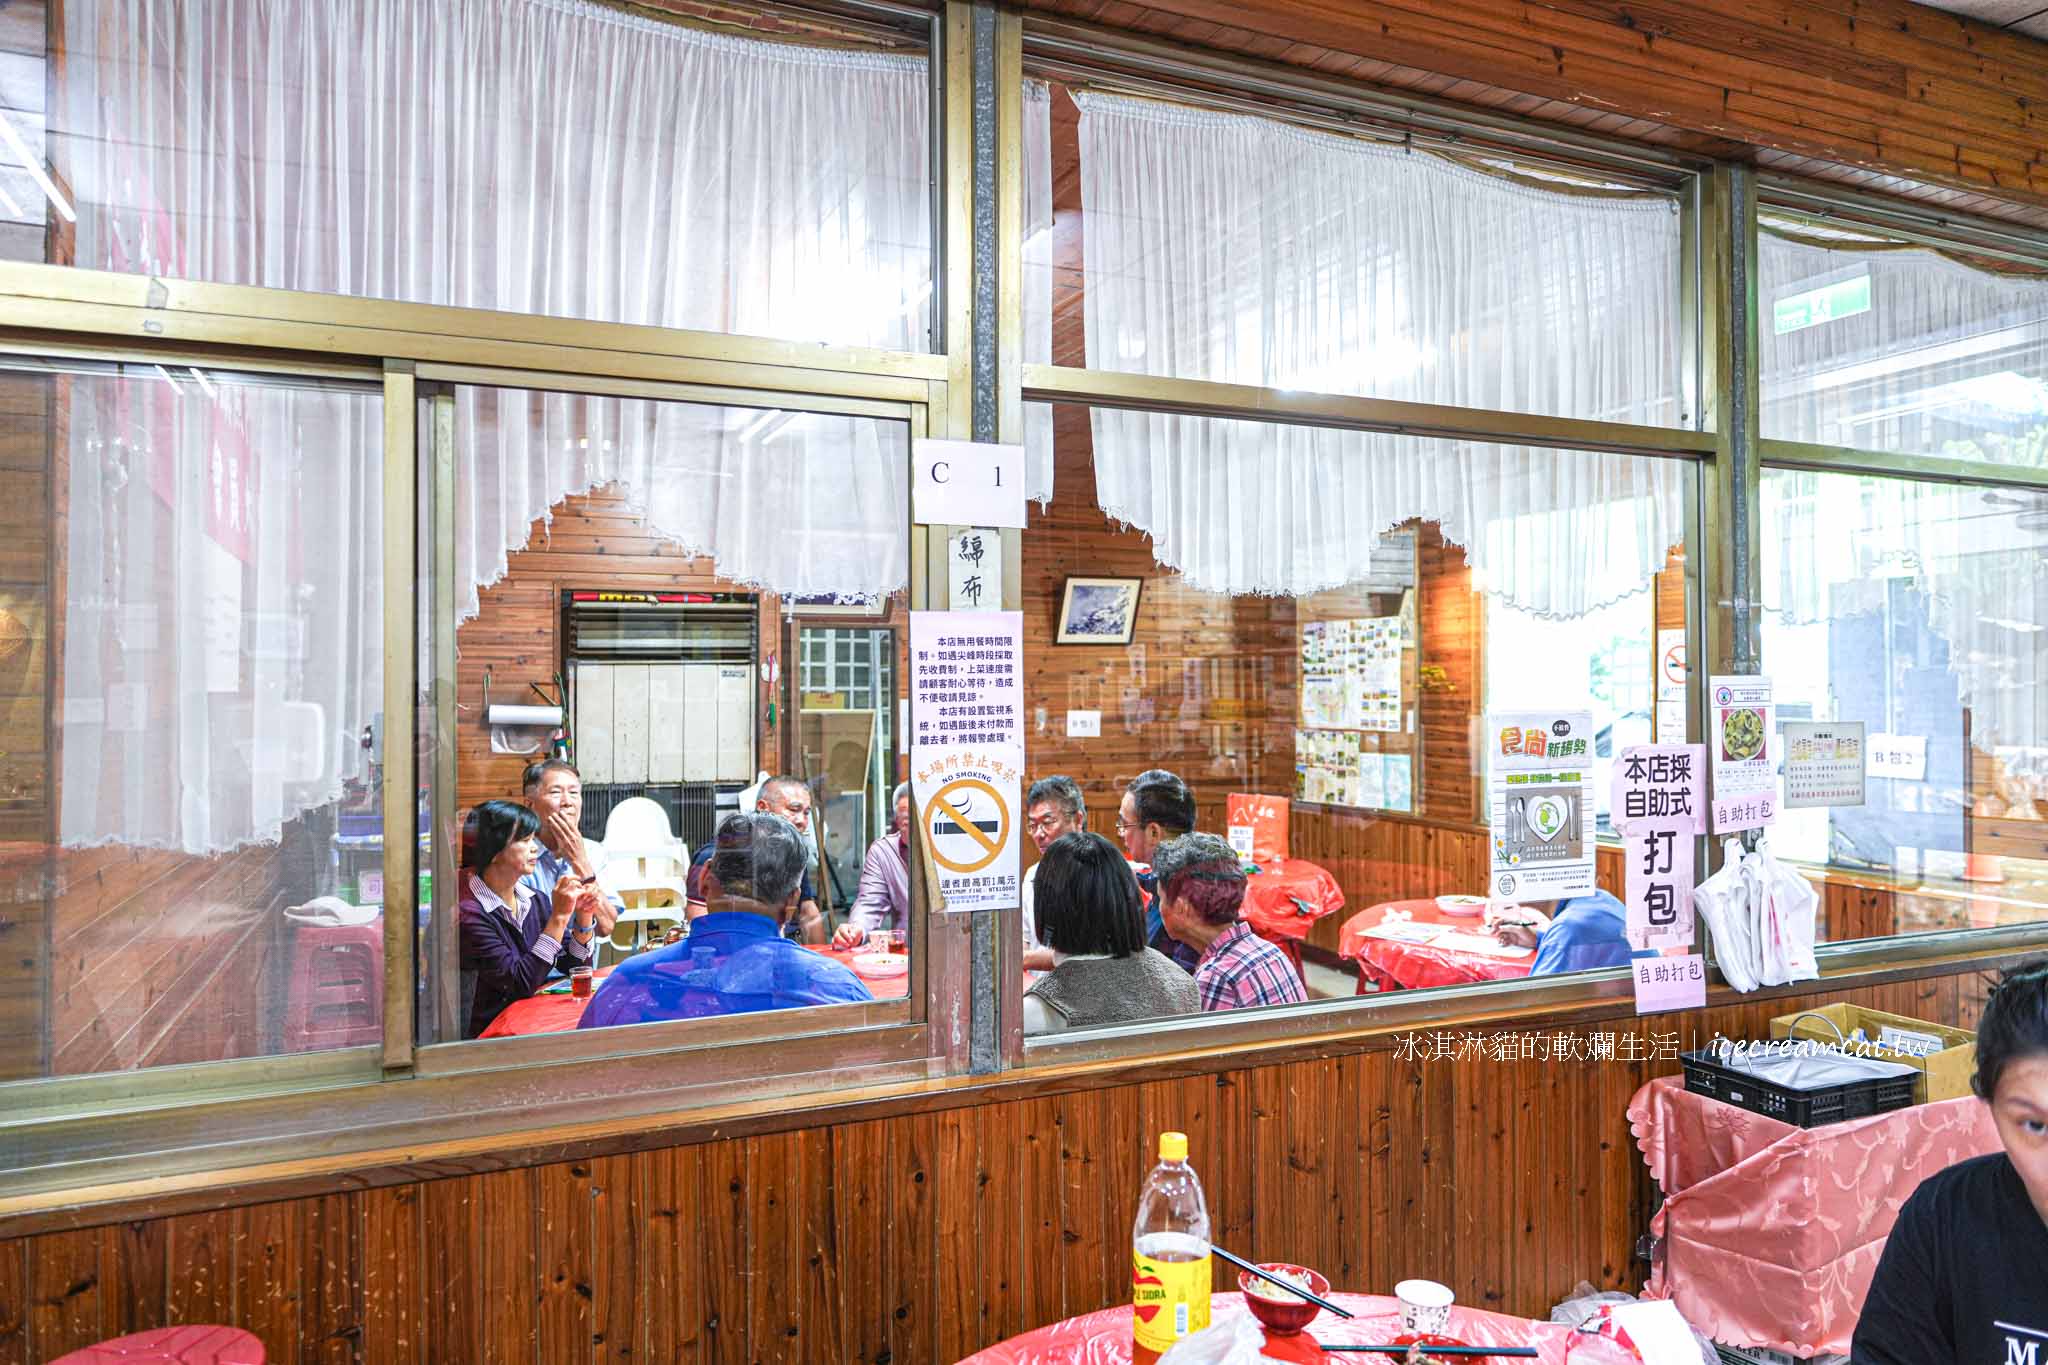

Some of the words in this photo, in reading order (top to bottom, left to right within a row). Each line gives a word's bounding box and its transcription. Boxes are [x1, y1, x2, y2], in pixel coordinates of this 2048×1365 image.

[931, 461, 950, 484] C
[994, 466, 1003, 487] 1
[937, 636, 1013, 647] 本店無用餐時間限
[939, 705, 1014, 717] 本店有設置監視系
[941, 775, 954, 785] NO
[955, 770, 993, 783] SMOKING
[1624, 753, 1692, 785] 本店採
[1625, 787, 1692, 818] 自助式
[1718, 800, 1774, 825] 自助打包
[1643, 829, 1677, 926] 打包
[1639, 960, 1703, 985] 自助打包
[2003, 1336, 2048, 1365] M
